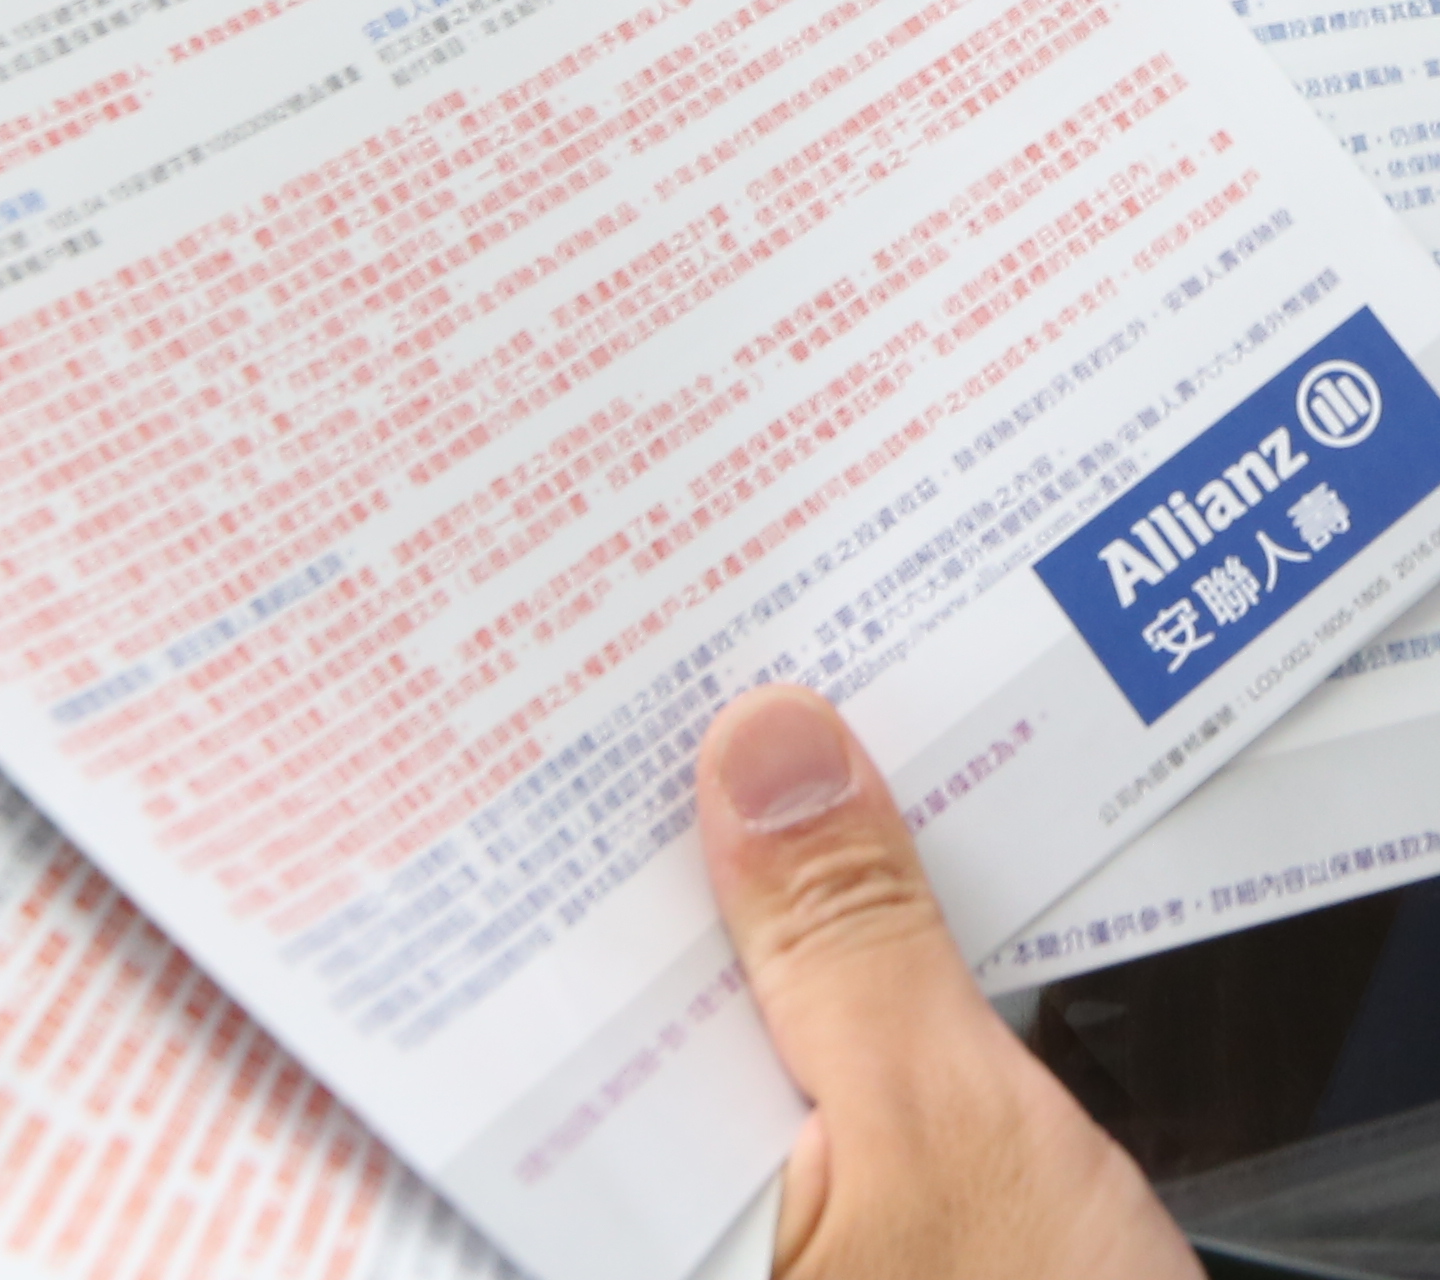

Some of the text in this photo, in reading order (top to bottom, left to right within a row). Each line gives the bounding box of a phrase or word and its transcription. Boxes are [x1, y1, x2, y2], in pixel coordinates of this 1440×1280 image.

[1096, 424, 1310, 608] Allianz
[1141, 481, 1353, 673] 安聯人壽
